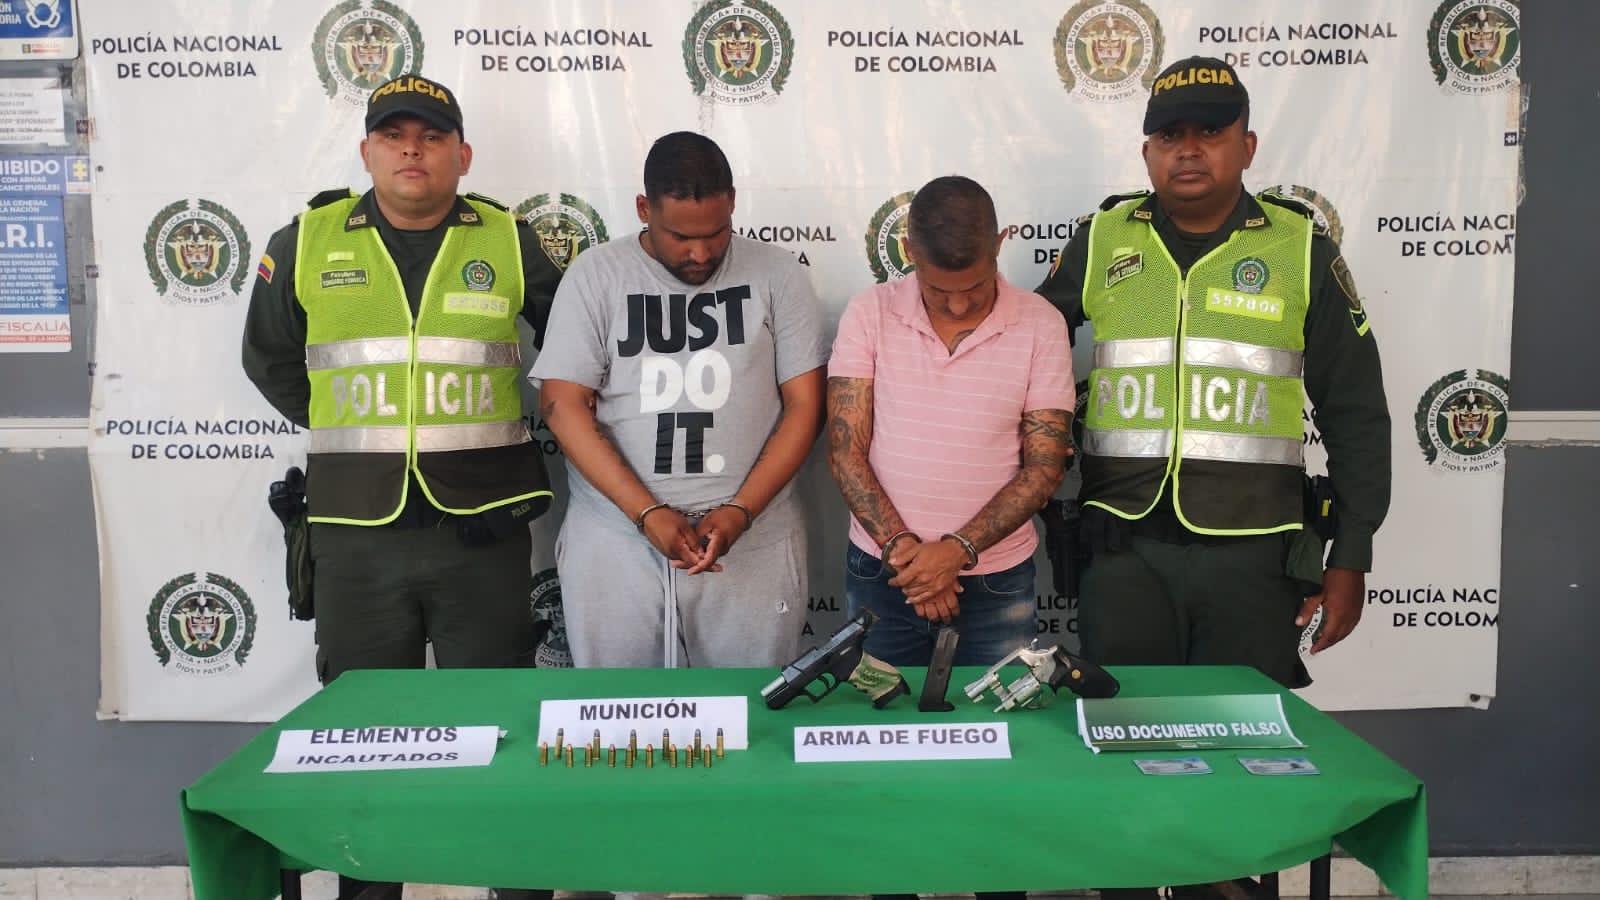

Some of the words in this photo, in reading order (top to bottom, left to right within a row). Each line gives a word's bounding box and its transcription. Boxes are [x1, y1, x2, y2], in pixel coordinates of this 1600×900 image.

[454, 26, 536, 48] POLICÍA
[544, 30, 652, 48] NACIONAL
[828, 26, 909, 48] POLICÍA
[916, 30, 1024, 47] NACIONAL
[1199, 21, 1281, 44] POLICÍA
[1288, 22, 1398, 41] NACIONAL
[92, 32, 167, 55] POLICÍA
[173, 35, 282, 52] NACIONAL
[482, 56, 508, 72] DE
[516, 56, 626, 72] COLOMBIA
[855, 56, 880, 72] DE
[887, 56, 998, 72] COLOMBIA
[1224, 52, 1250, 68] DE
[1258, 49, 1369, 67] COLOMBIA
[117, 63, 141, 79] DE
[147, 62, 257, 78] COLOMBIA
[372, 77, 449, 104] POLICIA
[1153, 68, 1233, 95] POLICIA
[1008, 218, 1073, 240] POLICÍ
[1377, 211, 1456, 232] POLICÍA
[1463, 214, 1515, 231] NACI
[1034, 248, 1059, 264] DE
[1402, 241, 1426, 256] DE
[617, 285, 752, 357] JUST
[640, 349, 731, 413] DO
[106, 416, 188, 435] POLICÍA
[195, 420, 301, 435] NACIONAL
[131, 444, 158, 459] DE
[164, 444, 275, 459] COLOMBIA
[654, 412, 725, 474] IT.
[1367, 584, 1446, 604] POLICÍA
[1453, 588, 1498, 604] NAC
[1393, 613, 1417, 627] DE
[579, 699, 697, 720] MUNICIÓN
[310, 727, 457, 745] ELEMENTOS
[803, 730, 871, 746] ARMA
[879, 730, 908, 746] DE
[918, 728, 998, 744] FUEGO
[1092, 726, 1126, 741] USO
[1129, 723, 1228, 740] DOCUMENTO
[1230, 722, 1282, 736] FALSO
[297, 752, 459, 765] INCAUTADOS
